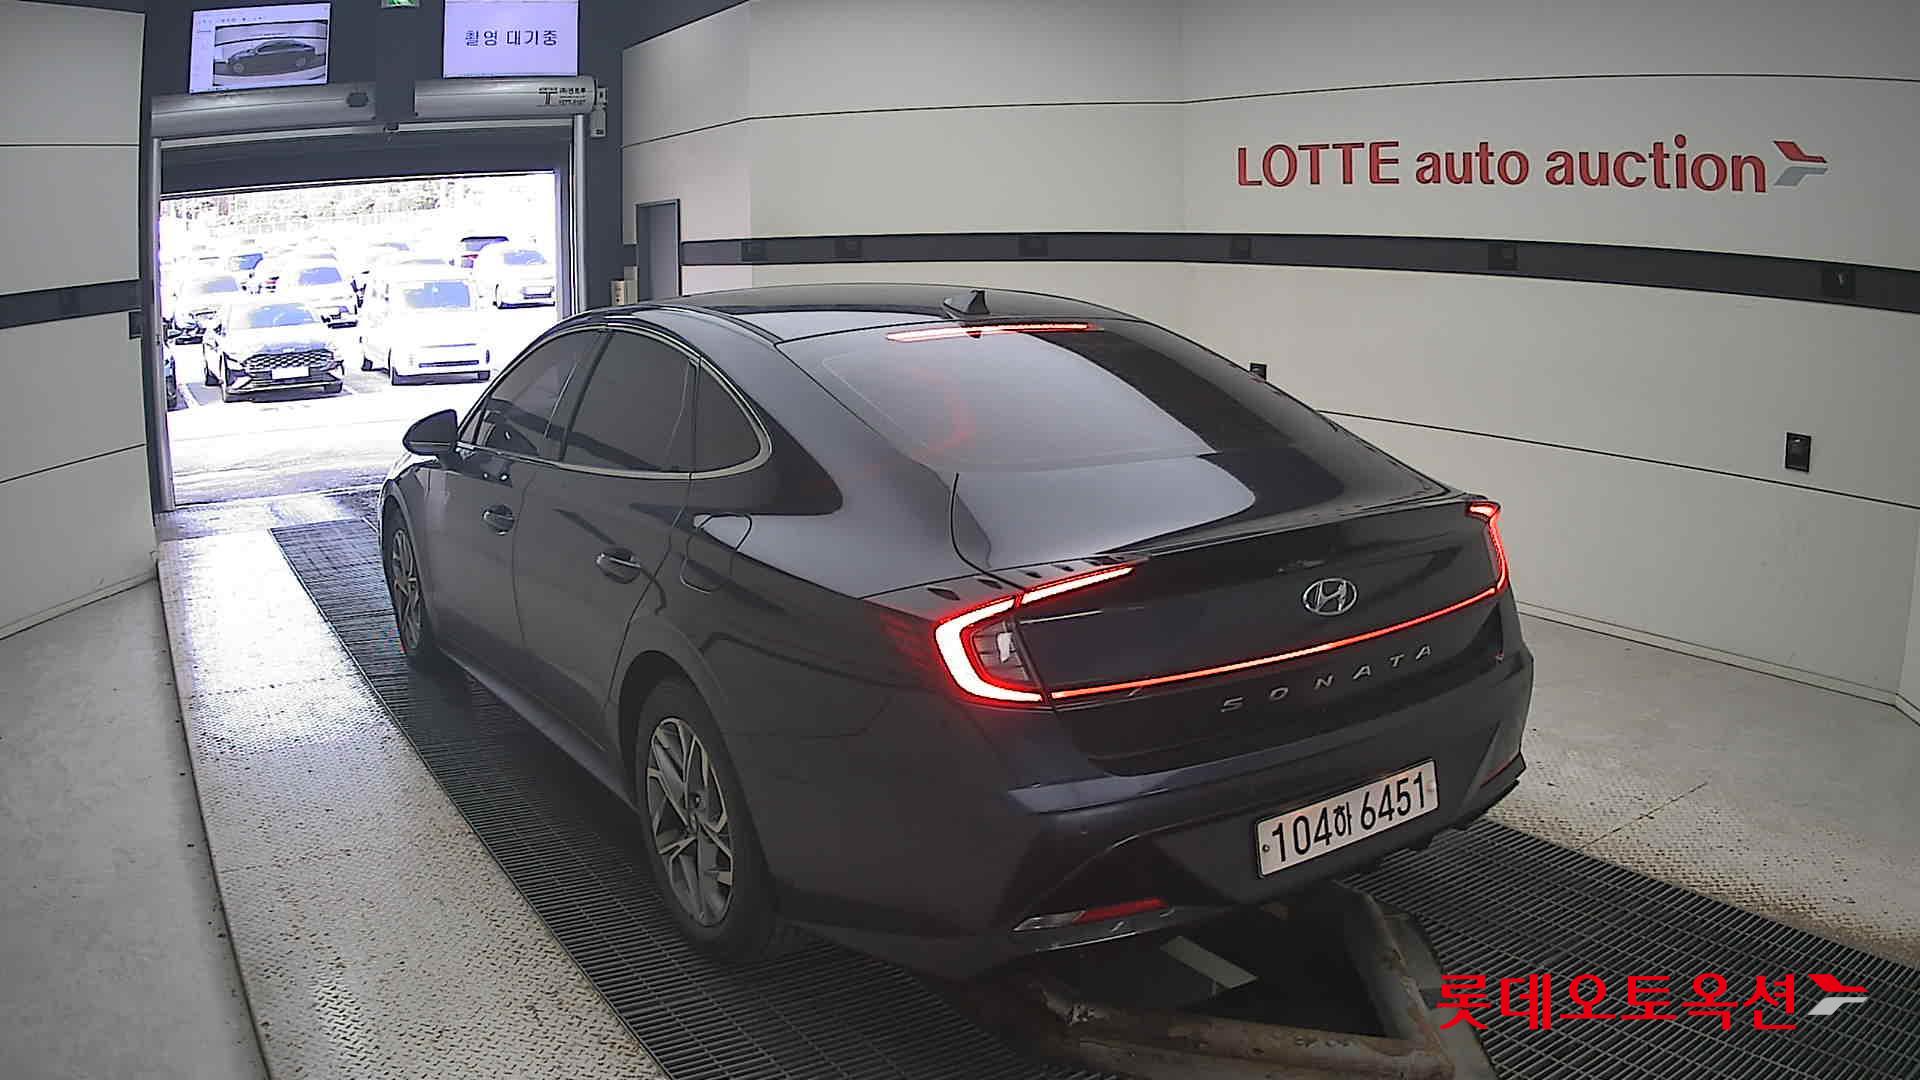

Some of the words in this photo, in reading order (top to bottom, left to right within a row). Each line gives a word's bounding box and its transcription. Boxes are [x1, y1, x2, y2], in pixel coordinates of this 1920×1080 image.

[465, 30, 498, 47] 촬영
[506, 30, 558, 46] 대기중
[1238, 141, 1400, 186] LOTTE
[1416, 141, 1530, 184] auto
[1546, 134, 1766, 193] auction
[1221, 644, 1432, 712] SONATA
[1272, 802, 1353, 862] 104하
[1360, 772, 1425, 830] 6451
